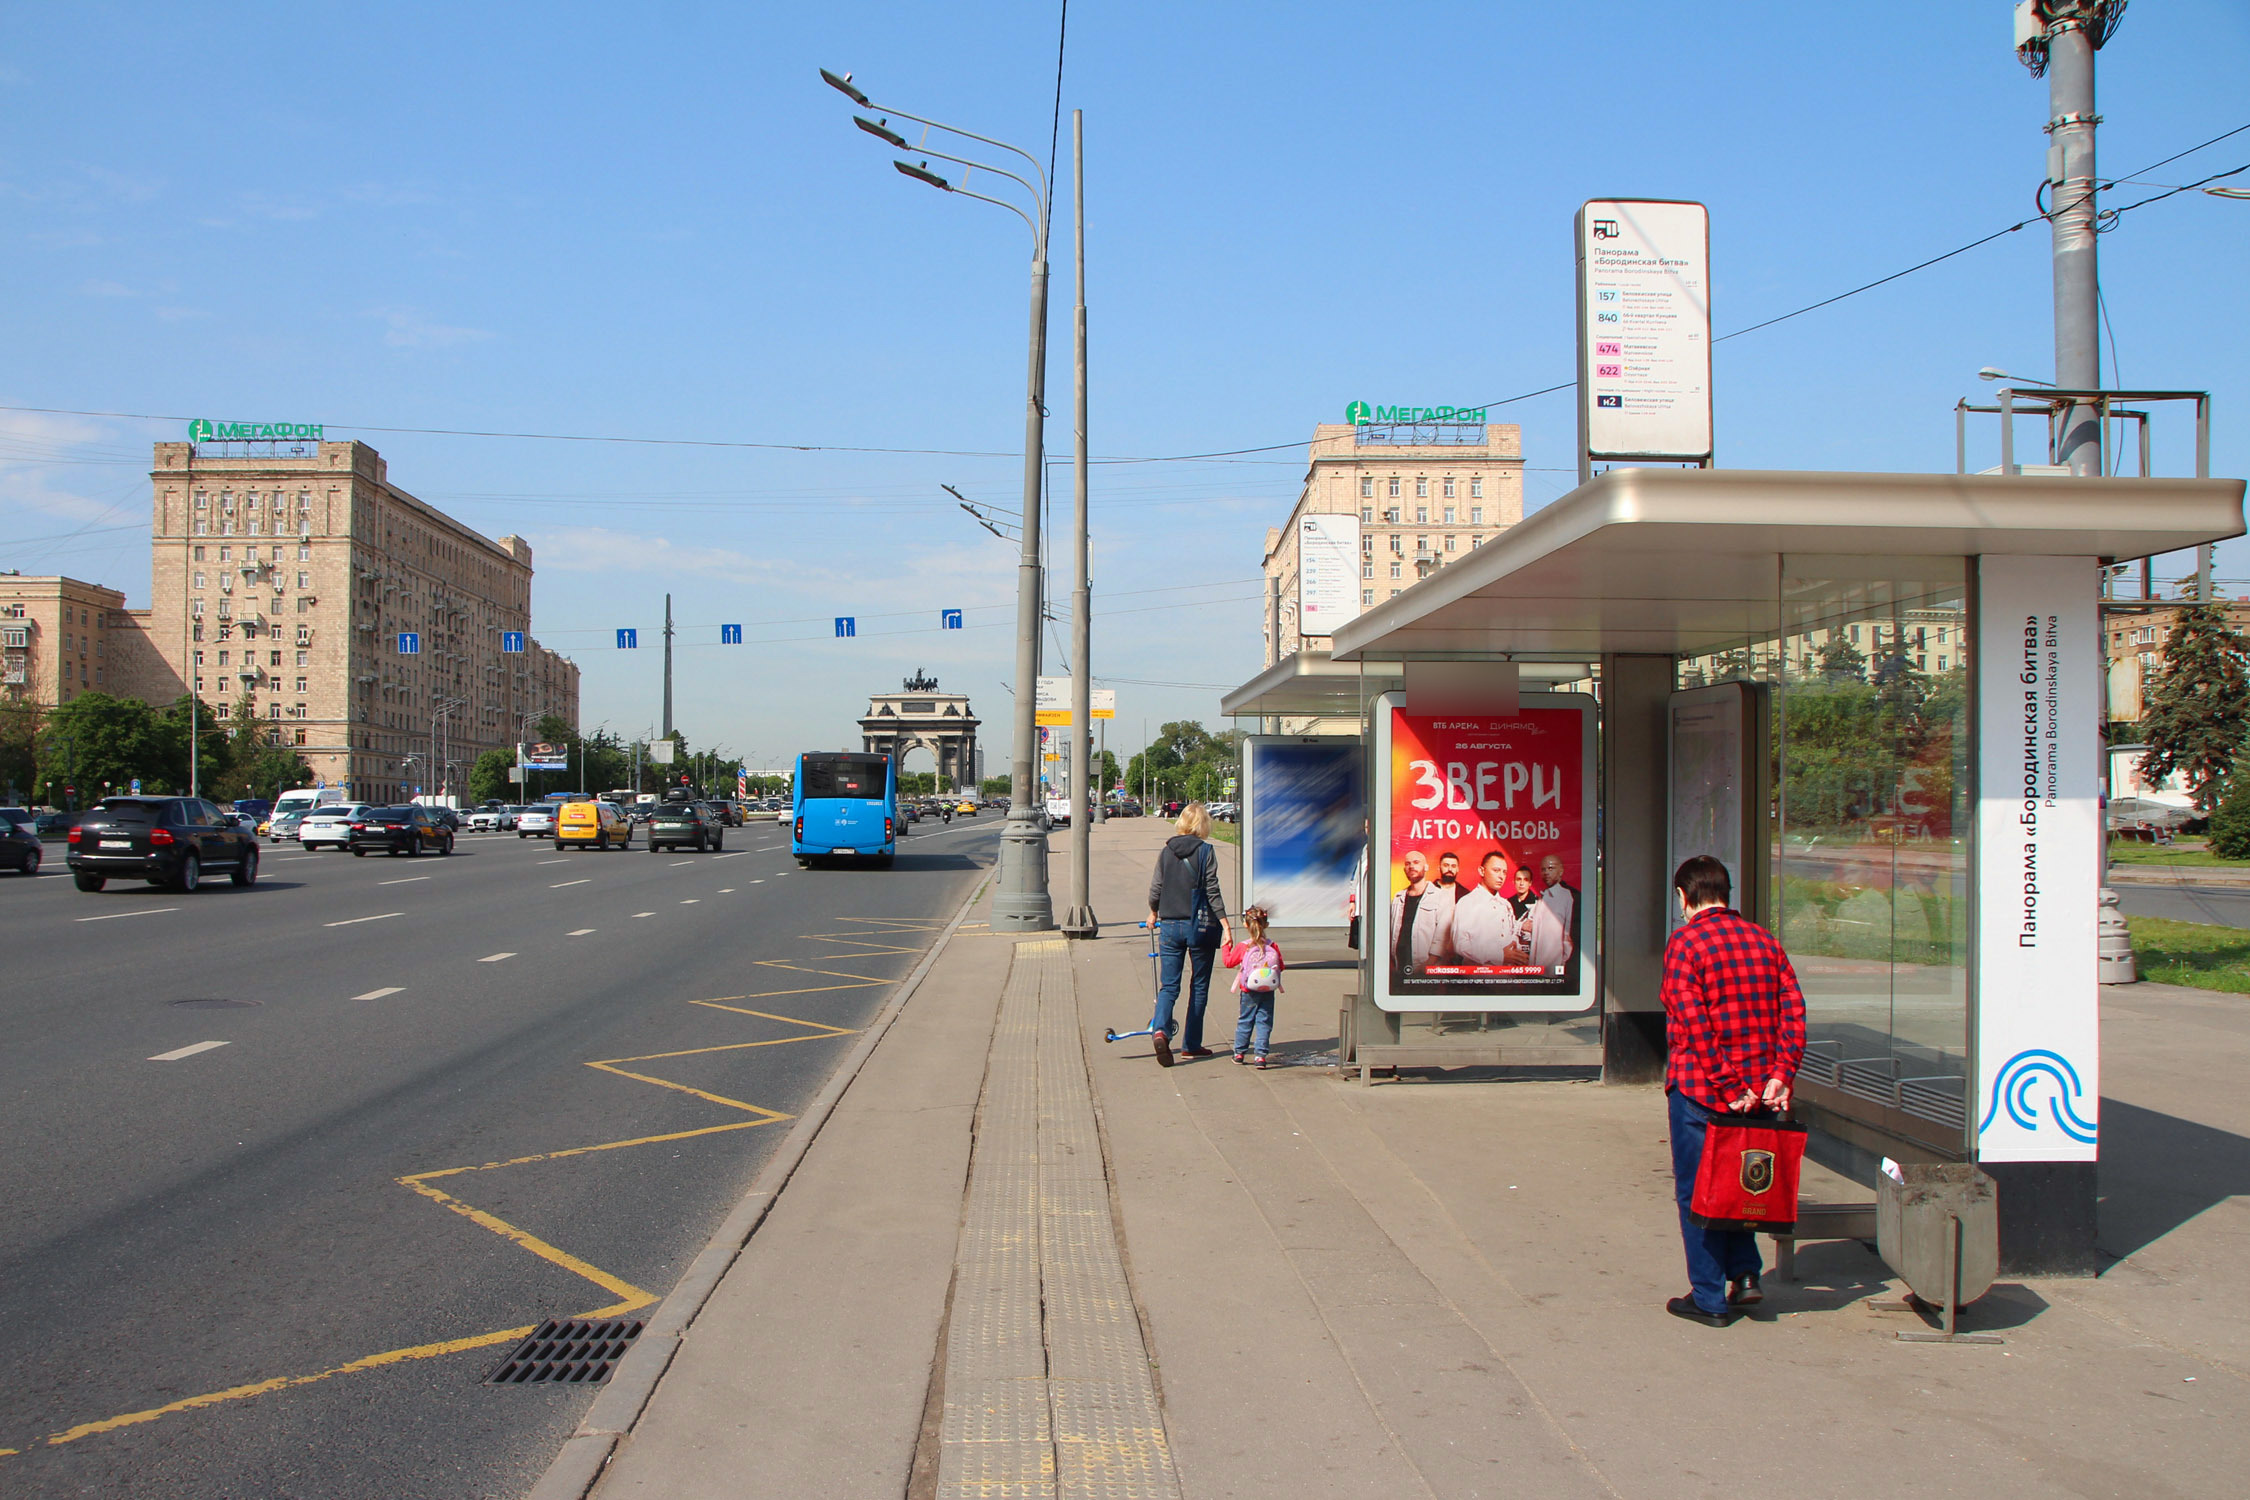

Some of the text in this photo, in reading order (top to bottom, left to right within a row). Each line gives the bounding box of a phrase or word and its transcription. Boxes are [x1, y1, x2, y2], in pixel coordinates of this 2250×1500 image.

[1594, 248, 1639, 258] Панорама
[1594, 257, 1689, 267] «Бородинская битва»
[1599, 292, 1615, 301] 157
[1598, 313, 1618, 323] 840
[1599, 345, 1618, 354] 474
[1600, 366, 1618, 376] 622
[2045, 615, 2059, 808] Panorama Borodinskaya Bitva
[1449, 722, 1480, 730] АРЕНА
[1490, 723, 1536, 731] ДИНАМО
[1409, 759, 1561, 810] ЗВЕРИ
[2019, 614, 2041, 948] Панорама «Бородинская битва»
[1410, 819, 1560, 840] ЛЕТО ЛЮБОВЬ
[1426, 966, 1466, 974] redkassa.ru
[1511, 966, 1524, 974] 665
[1525, 966, 1542, 974] 9999
